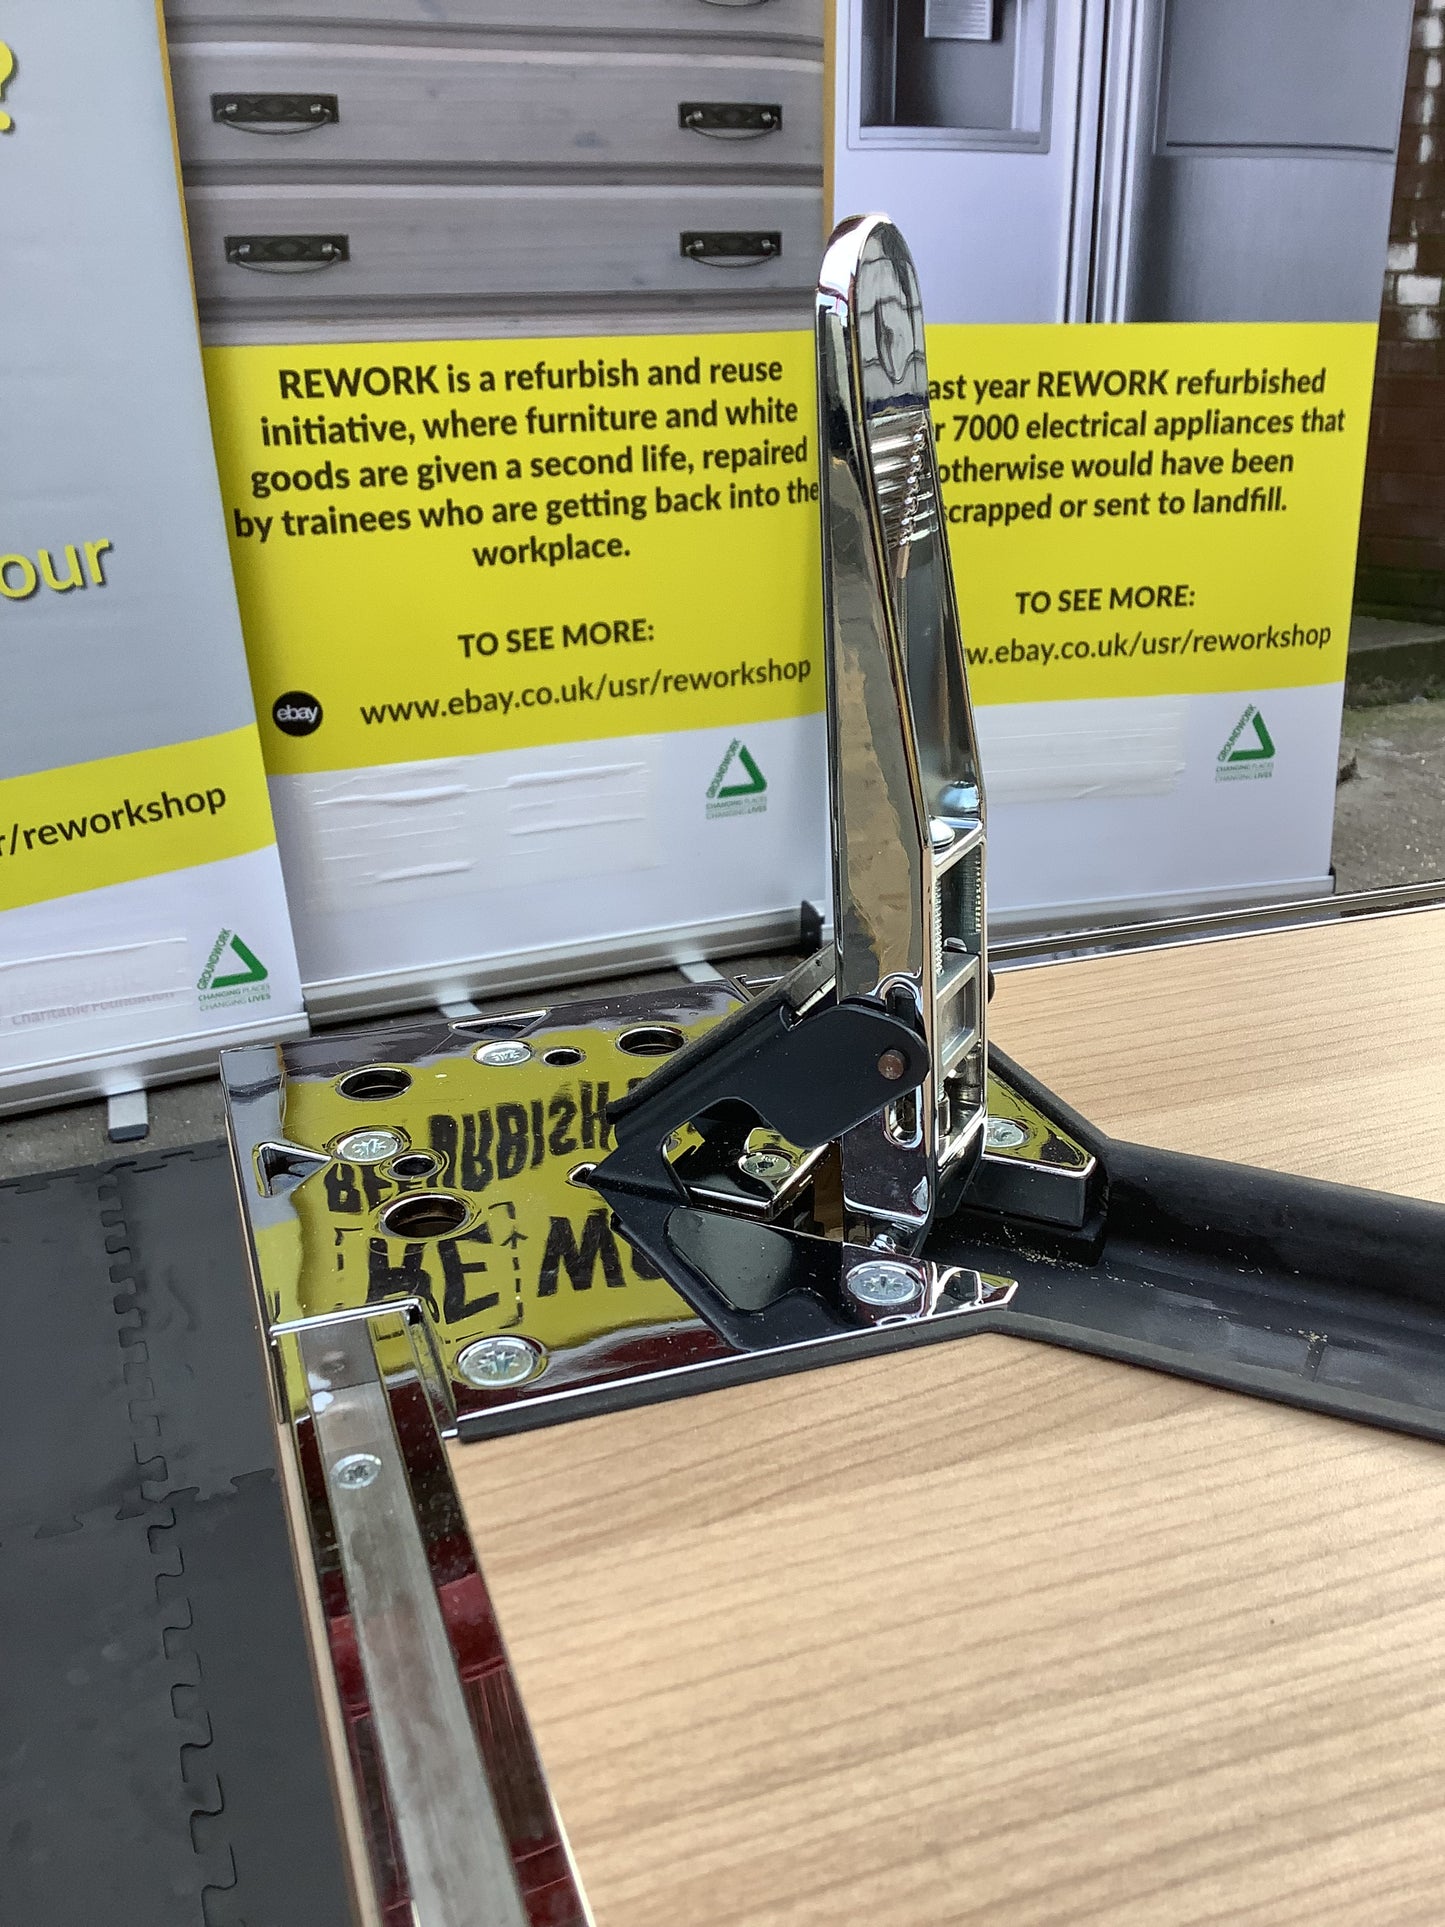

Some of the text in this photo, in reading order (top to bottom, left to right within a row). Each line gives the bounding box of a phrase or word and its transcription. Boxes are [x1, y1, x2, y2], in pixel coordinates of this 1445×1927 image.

[278, 356, 783, 400] REWORK is a refurbish and reuse
[927, 367, 1327, 405] ast year REWORK refurbished
[260, 396, 798, 447] initiative, where furniture and white
[952, 413, 1019, 442] 7000
[1026, 409, 1147, 440] electrical
[1153, 408, 1294, 441] appliances
[1301, 407, 1346, 433] that
[250, 435, 808, 499] goods are given a second life, repaired
[938, 448, 1294, 484] otherwise would have been
[233, 476, 820, 544] by trainees who are getting back into the
[1059, 499, 1088, 518] or
[1093, 492, 1151, 517] sent
[1158, 492, 1186, 515] to
[1192, 486, 1287, 514] landfill.
[472, 533, 631, 568] workplace.
[1015, 584, 1195, 615] TO SEE MORE:
[457, 618, 654, 658] TO SEE MORE:
[966, 623, 1331, 666] w.ebay.co.uk/usr/reworkshop
[359, 658, 812, 725] www.ebay.co.uk/usr/reworkshop
[276, 704, 318, 723] ebay
[1217, 703, 1257, 762] GROUNDWORK
[705, 736, 742, 799] GROUNDWORK
[196, 927, 232, 991] GROUNDWORK
[247, 991, 272, 1004] LIVES
